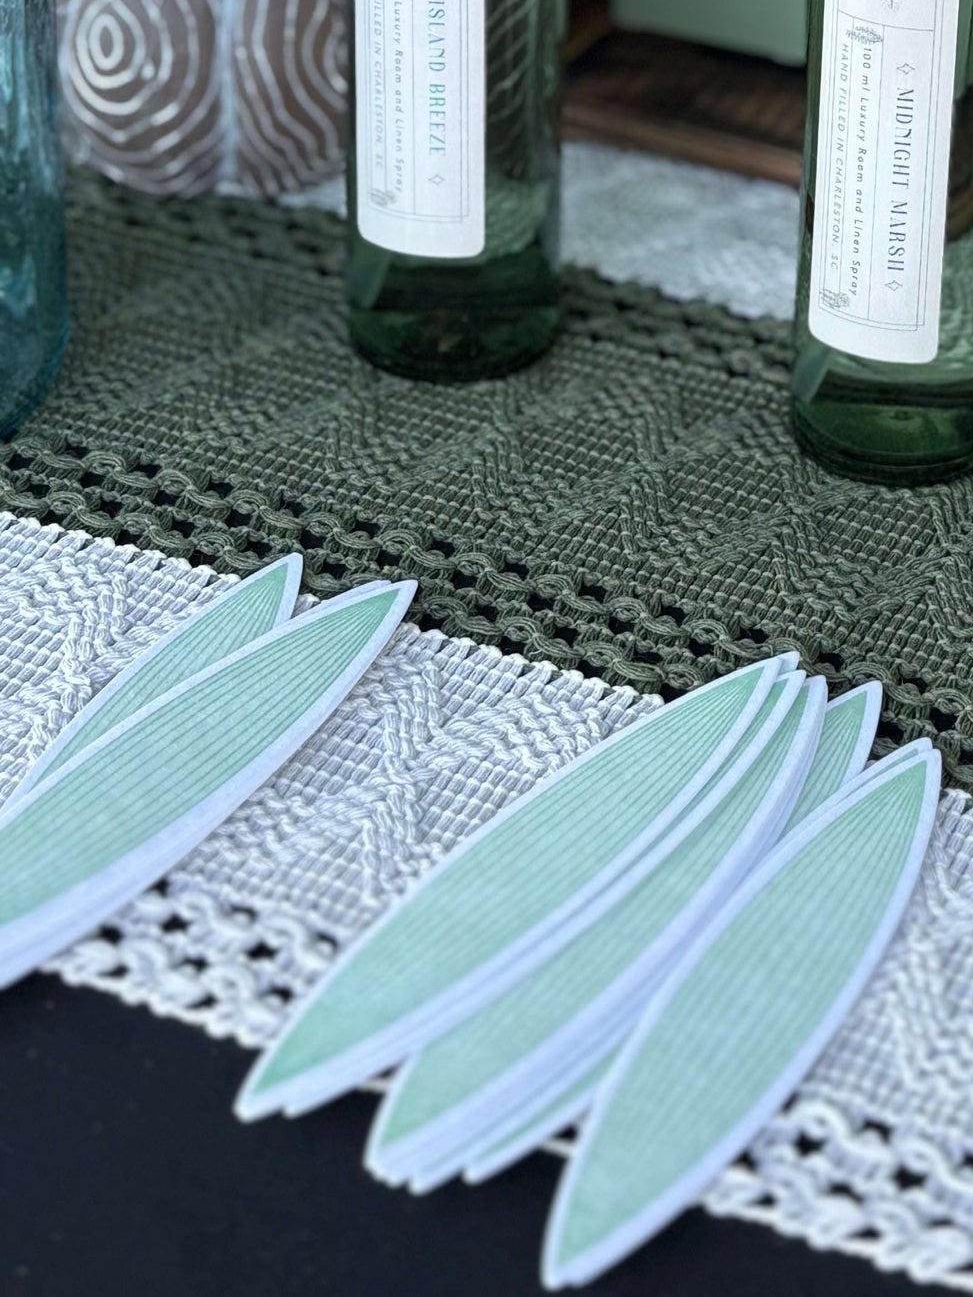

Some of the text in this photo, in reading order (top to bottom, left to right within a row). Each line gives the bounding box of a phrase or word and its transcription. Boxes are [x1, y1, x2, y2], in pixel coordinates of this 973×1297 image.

[392, 1, 404, 44] Luxury
[374, 42, 383, 53] IN
[840, 43, 850, 81] HAND
[395, 50, 404, 84] Room
[429, 1, 446, 155] ISLAND BREEZE
[395, 90, 404, 112] and
[838, 88, 847, 132] FILLED
[836, 138, 845, 152] IN
[849, 47, 872, 296] 100 ml Luxury Room and Linen Spray
[888, 88, 914, 270] MIDNIGHT MARSH
[831, 254, 839, 270] SC
